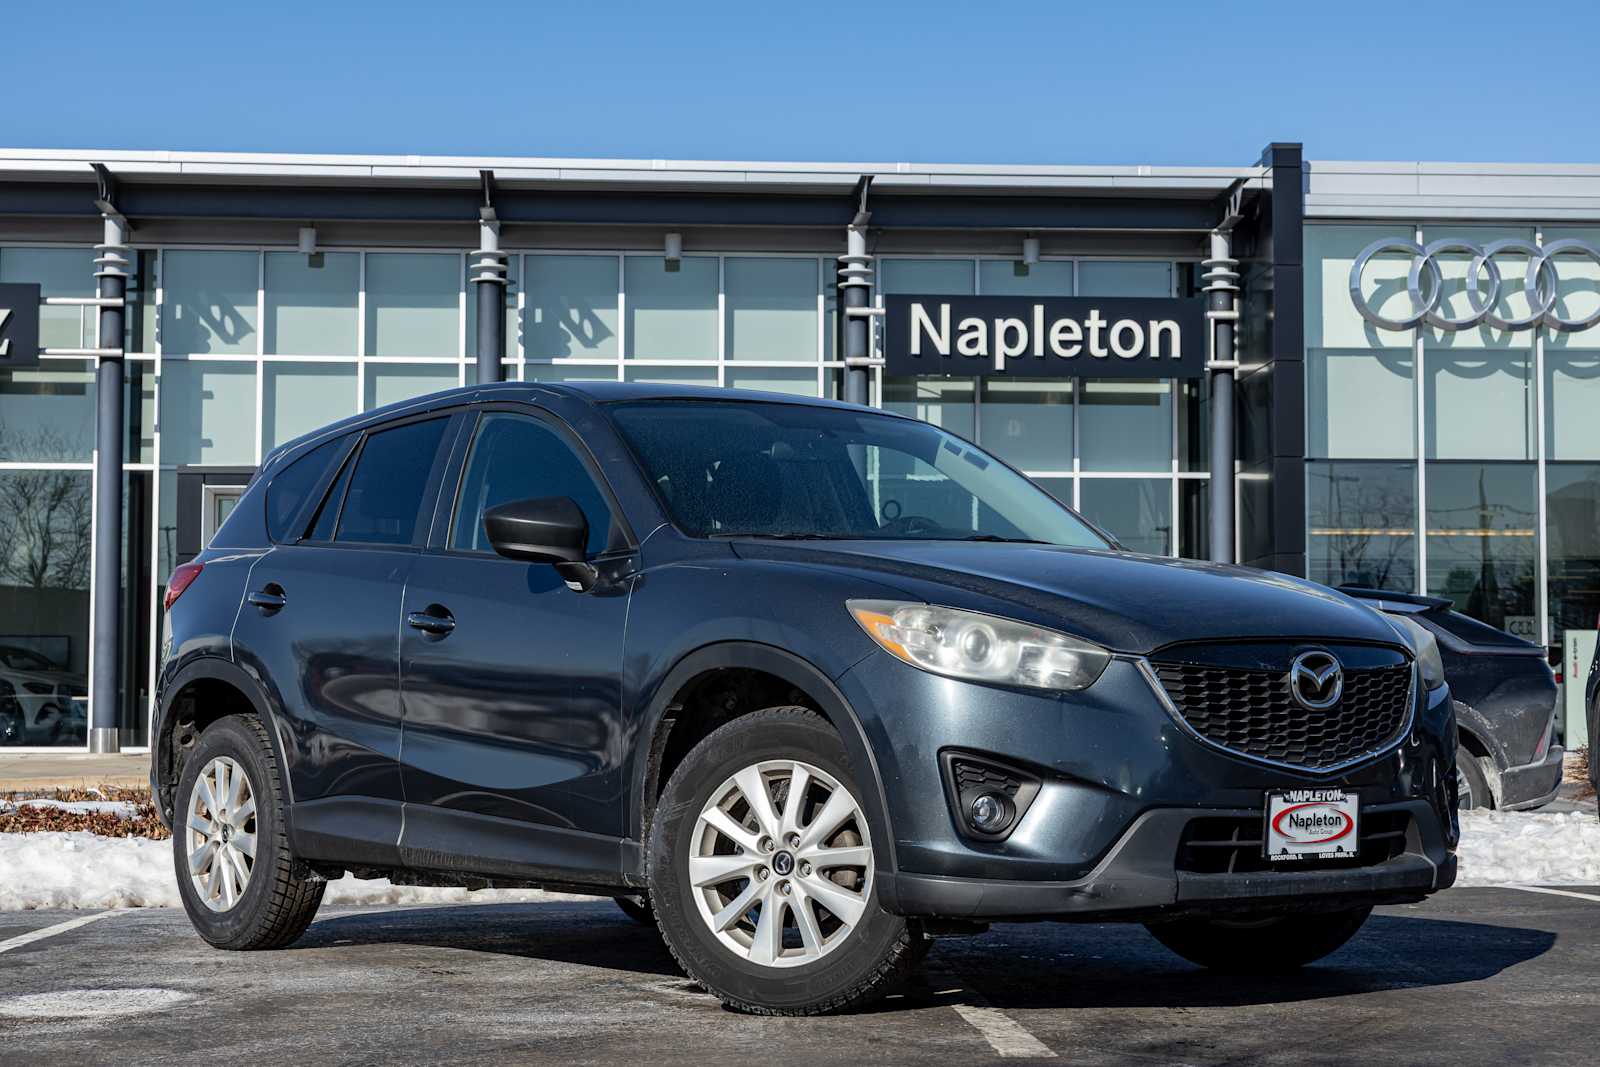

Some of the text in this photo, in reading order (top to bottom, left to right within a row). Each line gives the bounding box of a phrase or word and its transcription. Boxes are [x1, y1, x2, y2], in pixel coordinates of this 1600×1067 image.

[909, 303, 1182, 371] Napleton
[1289, 790, 1341, 801] NAPLETON
[1289, 813, 1342, 830] Napleton
